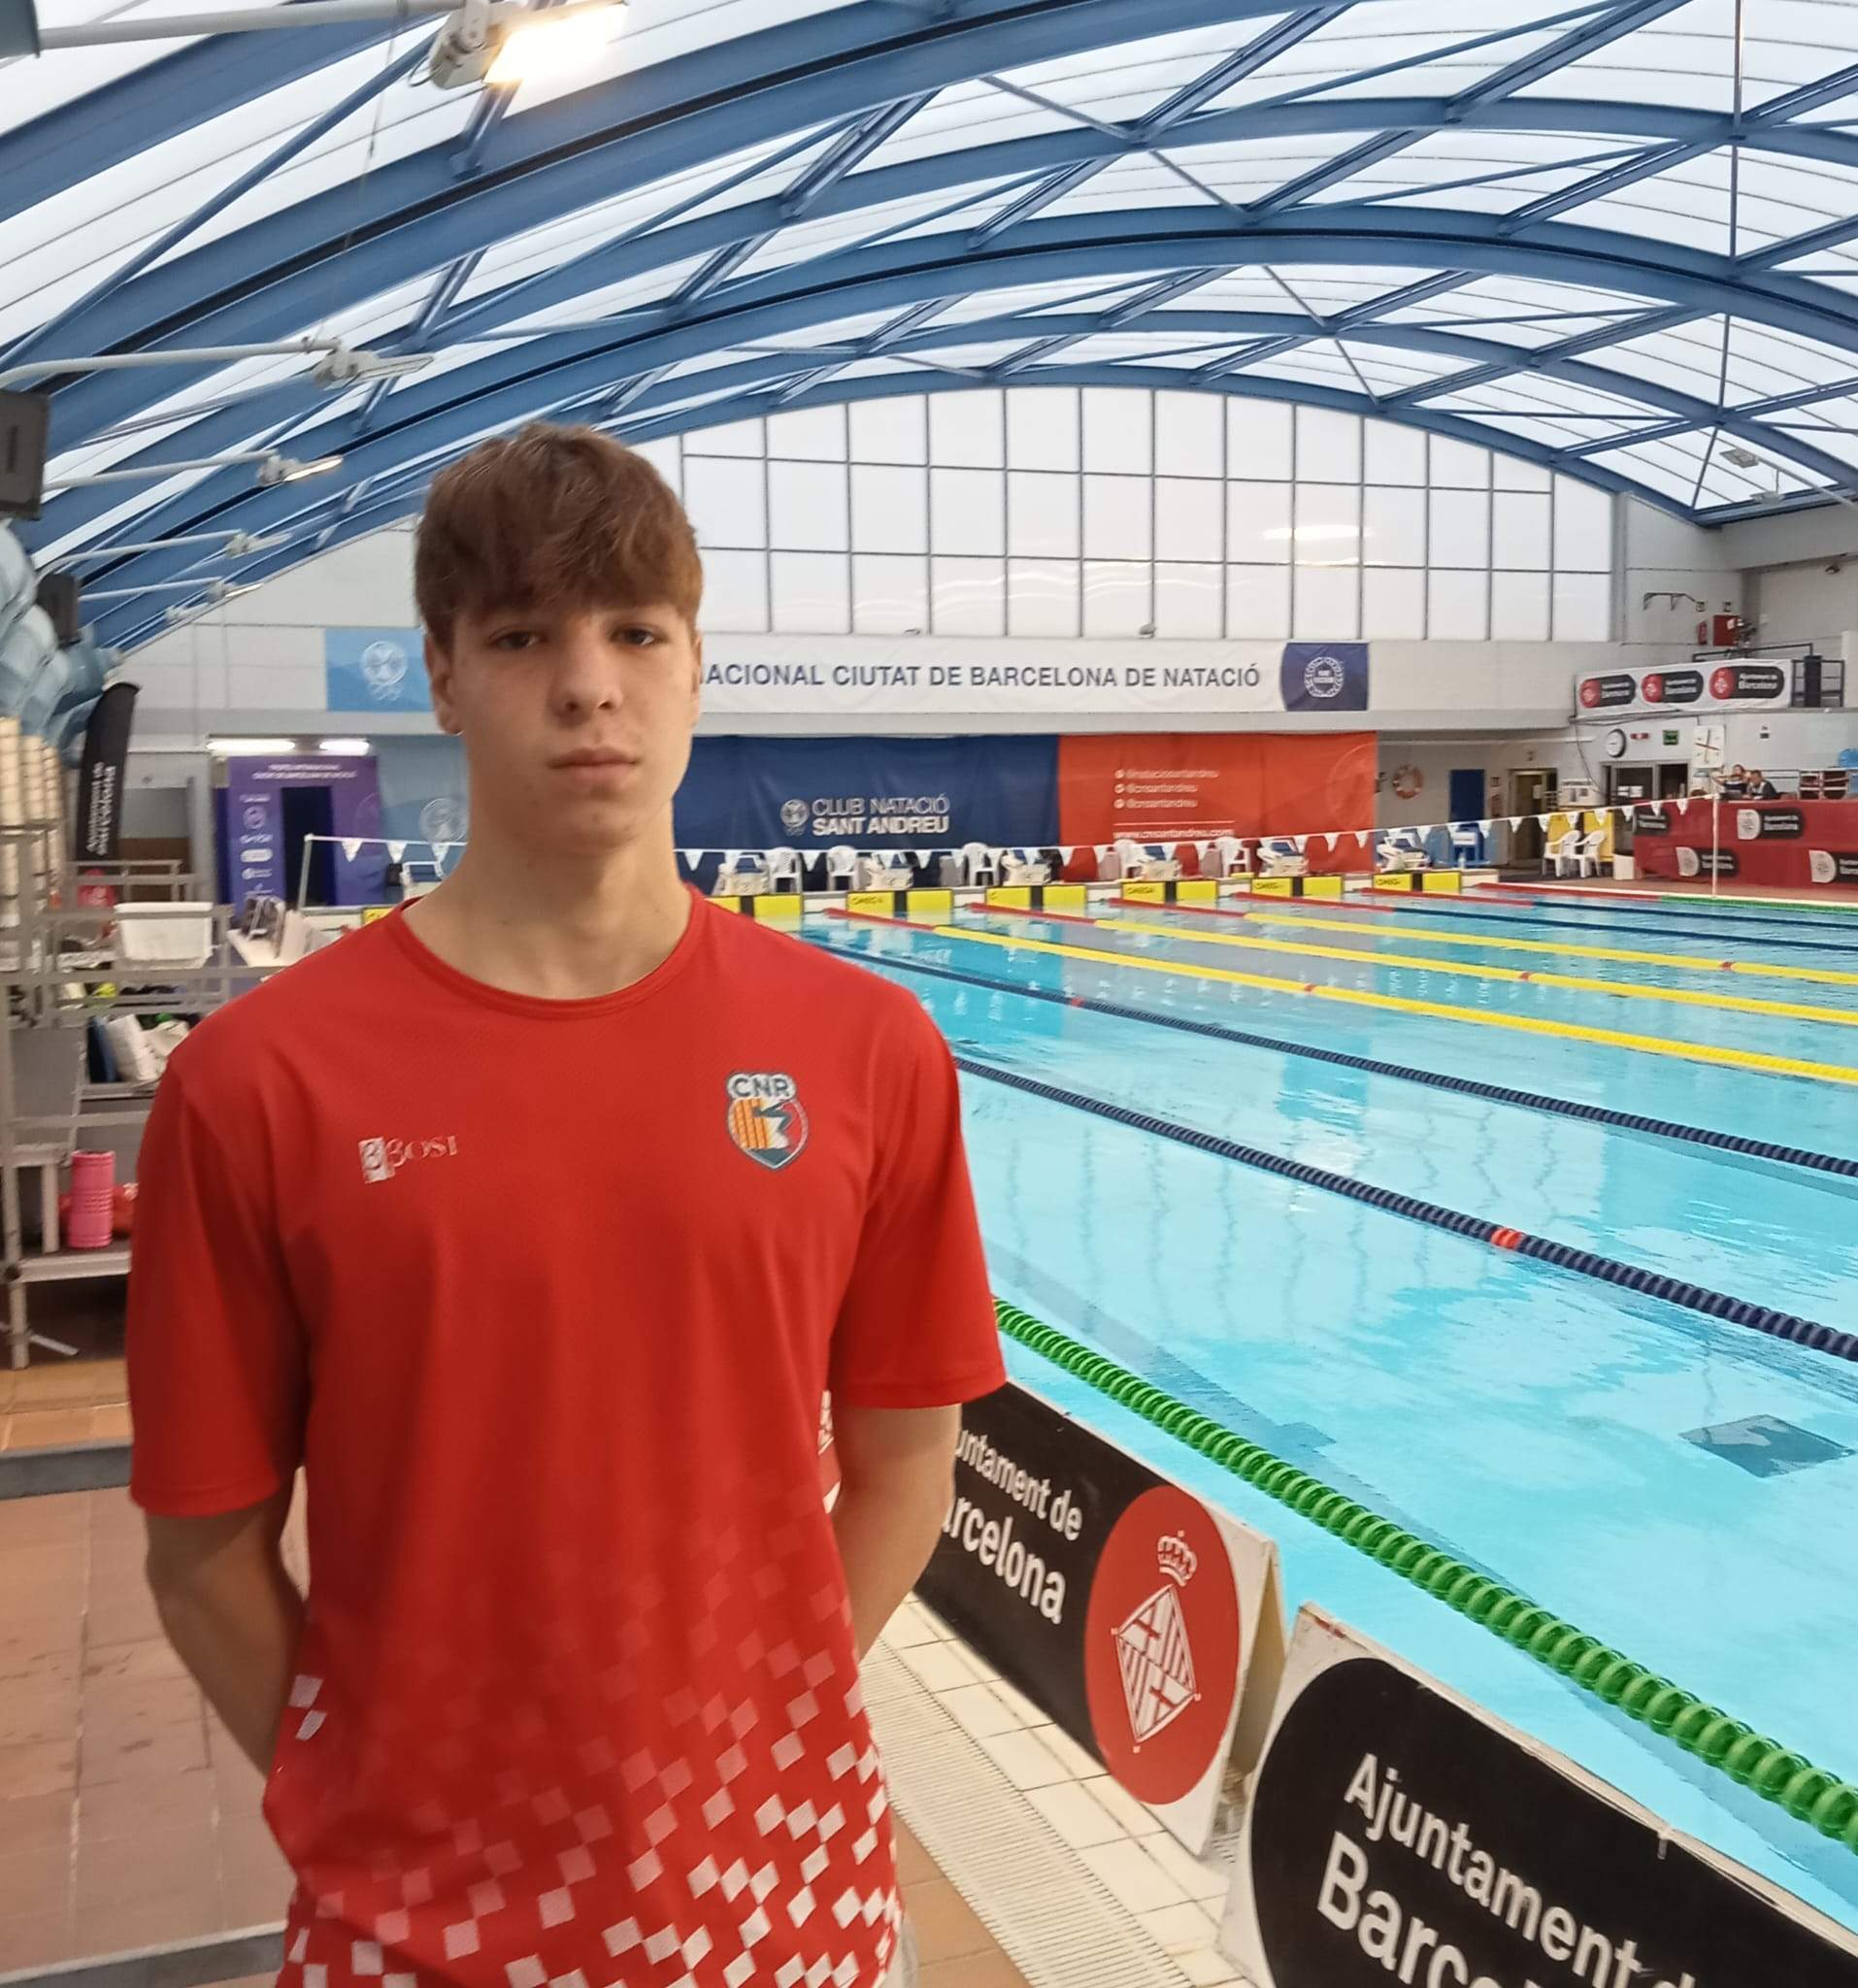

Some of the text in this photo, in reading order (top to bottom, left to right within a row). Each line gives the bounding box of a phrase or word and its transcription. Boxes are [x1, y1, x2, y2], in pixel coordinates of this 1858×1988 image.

[700, 663, 1260, 687] ACIONAL CIUTAT DE BARCELONA DE NATACIÓ
[812, 792, 951, 815] CLUB NATACIÓ
[813, 815, 950, 836] SANT ANDREU
[733, 1077, 790, 1098] CNR
[1049, 1490, 1082, 1541] de
[1344, 1751, 1642, 1988] Ajuntament
